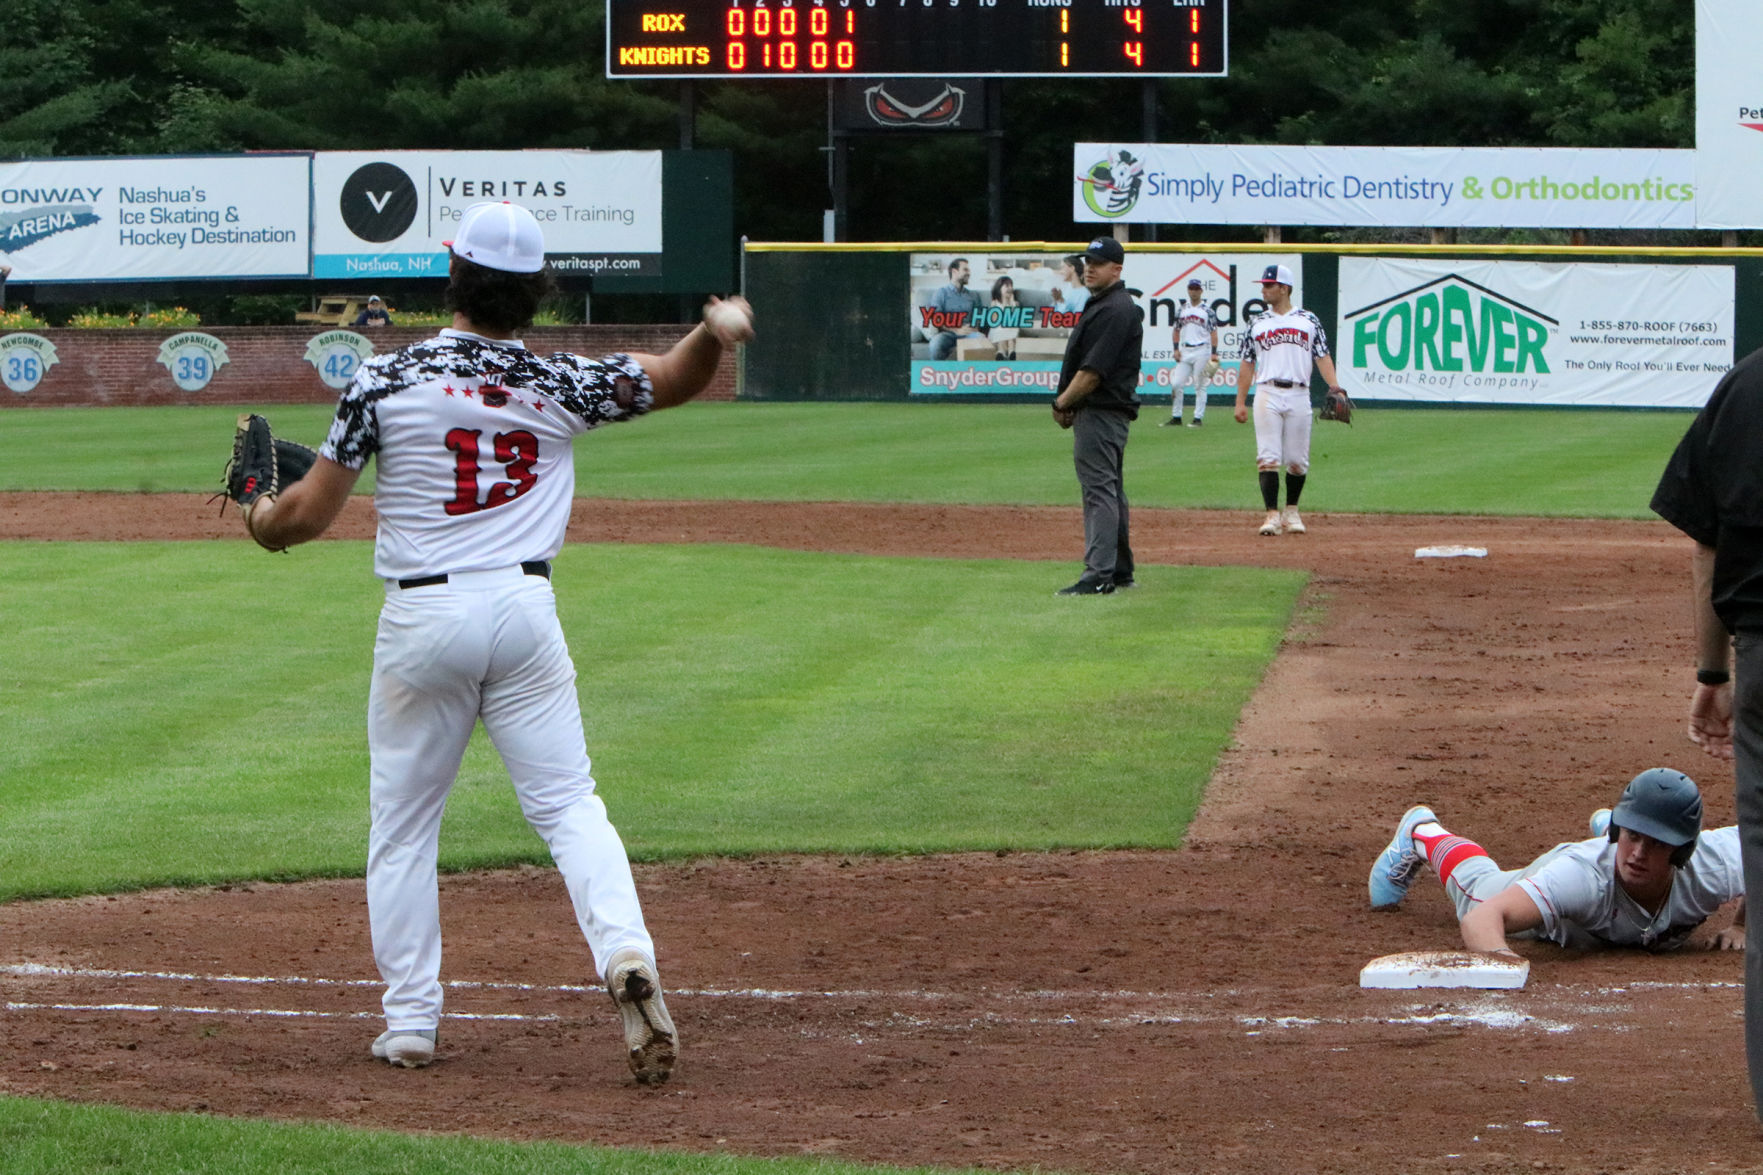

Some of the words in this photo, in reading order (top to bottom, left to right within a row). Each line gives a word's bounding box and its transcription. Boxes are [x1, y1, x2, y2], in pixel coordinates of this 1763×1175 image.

[642, 14, 685, 32] ROX
[728, 8, 744, 35] 0
[754, 8, 770, 35] 0
[780, 8, 795, 35] 0
[811, 8, 827, 35] 0
[1061, 8, 1069, 33] 1
[1124, 8, 1142, 33] 4
[1191, 8, 1199, 33] 1
[620, 47, 710, 65] KNIGHTS
[728, 42, 744, 69] 0
[780, 42, 795, 69] 0
[811, 42, 827, 69] 0
[837, 42, 853, 69] 0
[1061, 42, 1069, 67] 1
[1124, 42, 1142, 67] 4
[1191, 42, 1199, 67] 1
[1, 187, 104, 204] ONWAY
[120, 186, 206, 204] Nashua's
[440, 178, 568, 197] VERITAS
[1148, 172, 1224, 204] Simply
[1232, 174, 1335, 199] Pediatric
[1343, 176, 1454, 206] Dentistry
[1462, 176, 1484, 200] &
[1491, 176, 1694, 201] Orthodontics
[9, 211, 76, 240] ARENA
[120, 208, 145, 224] Ice
[150, 207, 220, 228] Skating
[225, 206, 240, 222] &
[564, 206, 635, 226] Training
[120, 228, 186, 249] Hockey
[191, 226, 296, 245] Destination
[346, 258, 403, 273] Nashua,
[408, 257, 432, 270] NH
[542, 256, 641, 272] veritaspt.com
[920, 306, 968, 328] Your
[970, 306, 1035, 328] HOME
[1580, 320, 1676, 332] 1-855-870-ROOF
[1679, 322, 1718, 334] (7663)
[1352, 284, 1551, 374] FOREVER
[0, 336, 44, 350] NEWCOMBE
[168, 336, 218, 350] CAMPANELLA
[319, 334, 361, 346] ROBINSON
[1570, 335, 1726, 346] www.forevermetalroof.com
[8, 358, 38, 382] 36
[178, 356, 206, 380] 39
[324, 354, 353, 378] 42
[1565, 360, 1584, 370] The
[1588, 360, 1612, 373] Only
[1616, 361, 1640, 370] Roof
[1643, 361, 1672, 372] You'll
[1676, 362, 1700, 372] Ever
[1364, 372, 1410, 384] Metal
[1418, 374, 1456, 389] Roof
[1464, 374, 1538, 390] Company
[444, 428, 539, 516] 13
